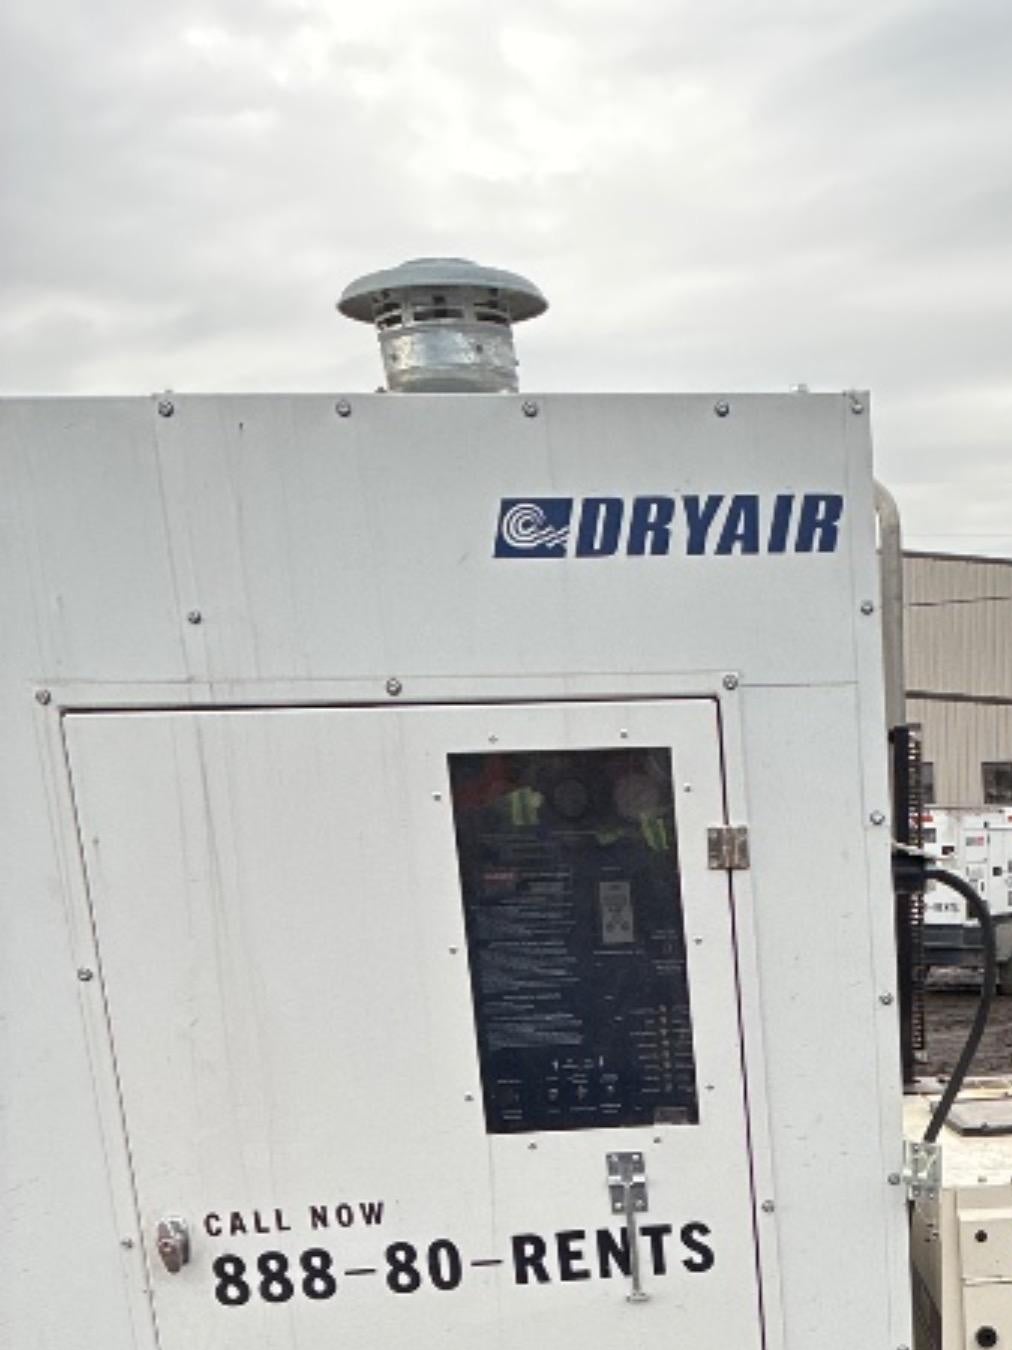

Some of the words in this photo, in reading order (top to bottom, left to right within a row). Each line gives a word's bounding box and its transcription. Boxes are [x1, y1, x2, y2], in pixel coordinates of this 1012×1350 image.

[575, 494, 844, 558] DRYAIR
[203, 1208, 292, 1237] CALL
[310, 1201, 385, 1230] NOW
